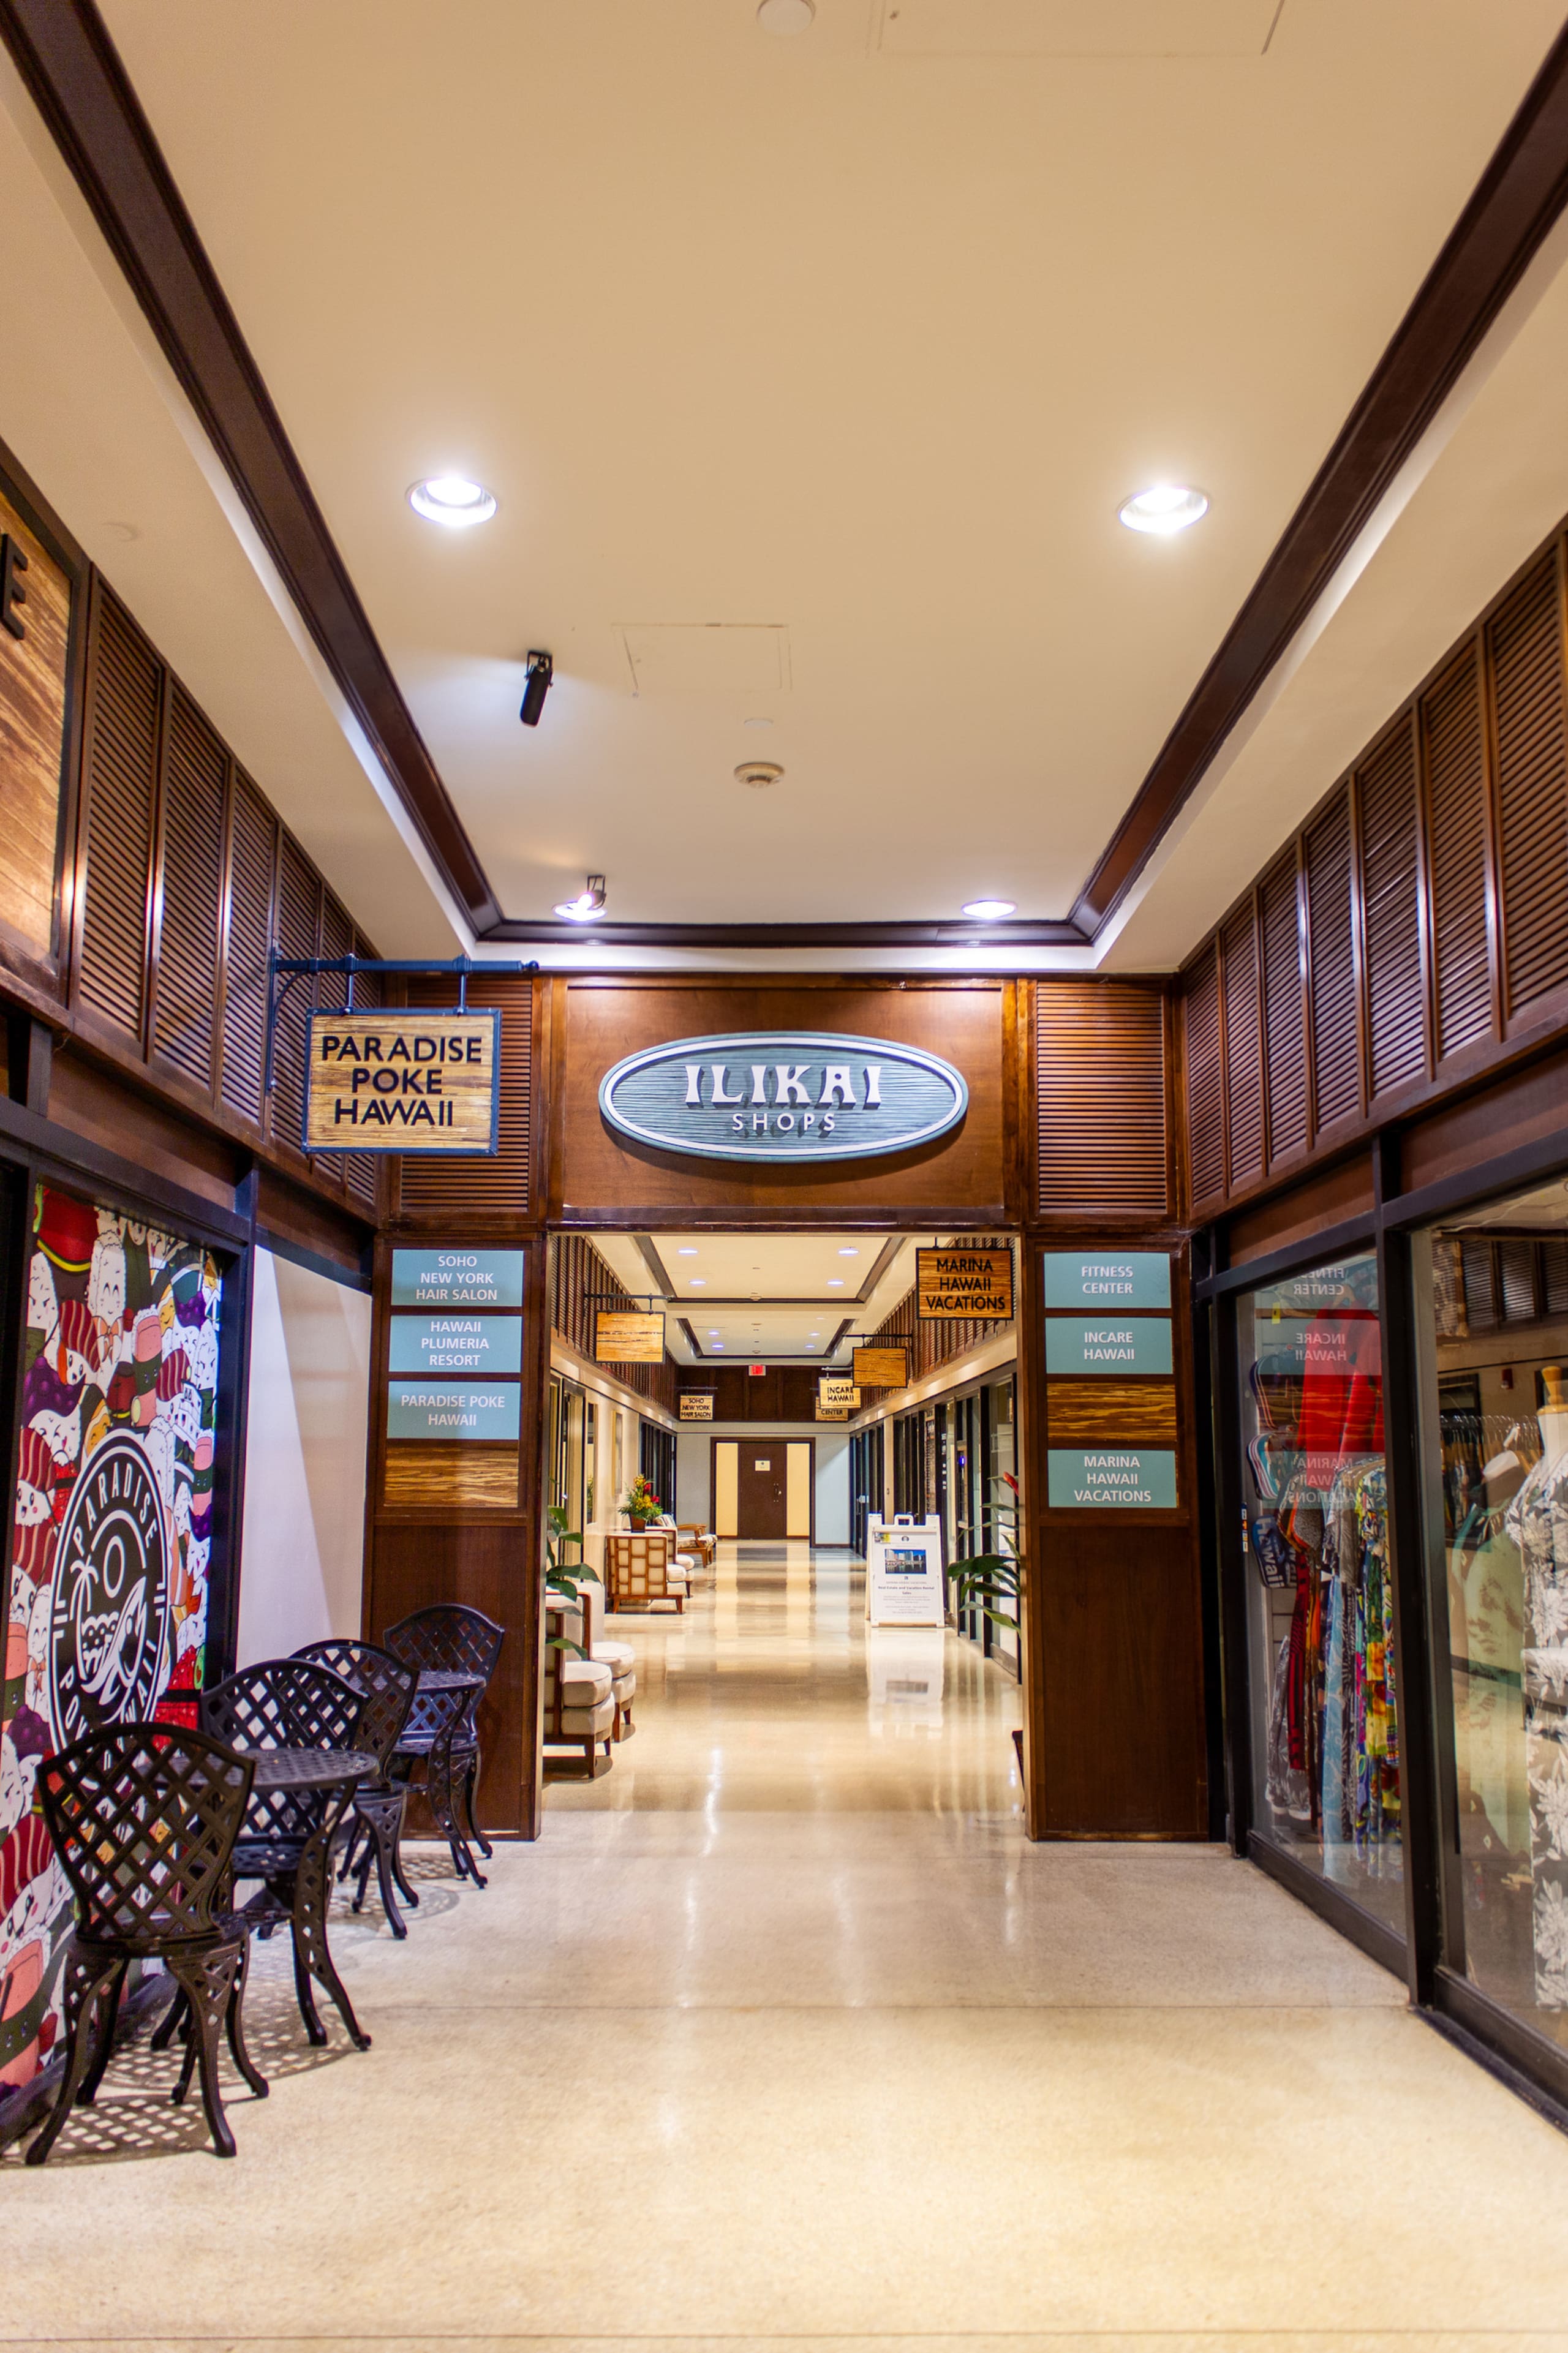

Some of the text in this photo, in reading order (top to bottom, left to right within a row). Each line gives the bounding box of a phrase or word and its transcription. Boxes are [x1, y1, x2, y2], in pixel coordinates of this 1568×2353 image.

[322, 1036, 482, 1063] PARADISE
[352, 1068, 443, 1094] POKE
[685, 1064, 882, 1104] ILIKAI
[334, 1099, 453, 1126] HAWAII
[732, 1113, 836, 1131] SHOPS
[438, 1256, 477, 1267] SOHO
[936, 1259, 993, 1272] MARINA
[1081, 1266, 1133, 1278] FITNESS
[420, 1273, 494, 1284] NEW YORK
[940, 1277, 991, 1291] HAWAII
[1082, 1282, 1133, 1294] CENTER
[416, 1289, 497, 1301] HAIR SALON
[926, 1296, 1006, 1310] VACATIONS
[431, 1321, 481, 1333] HAWAII
[421, 1338, 489, 1349] PLUMERIA
[1084, 1332, 1133, 1343] INCARE
[429, 1354, 480, 1366] RESORT
[1084, 1349, 1135, 1360] HAWAII
[401, 1395, 505, 1408] PARADISE POKE
[428, 1414, 477, 1426] HAWAII
[1084, 1456, 1140, 1467] MARINA
[1087, 1473, 1138, 1485] HAWAII
[1074, 1490, 1152, 1502] VACATIONS
[73, 1461, 157, 1557] PARADISE
